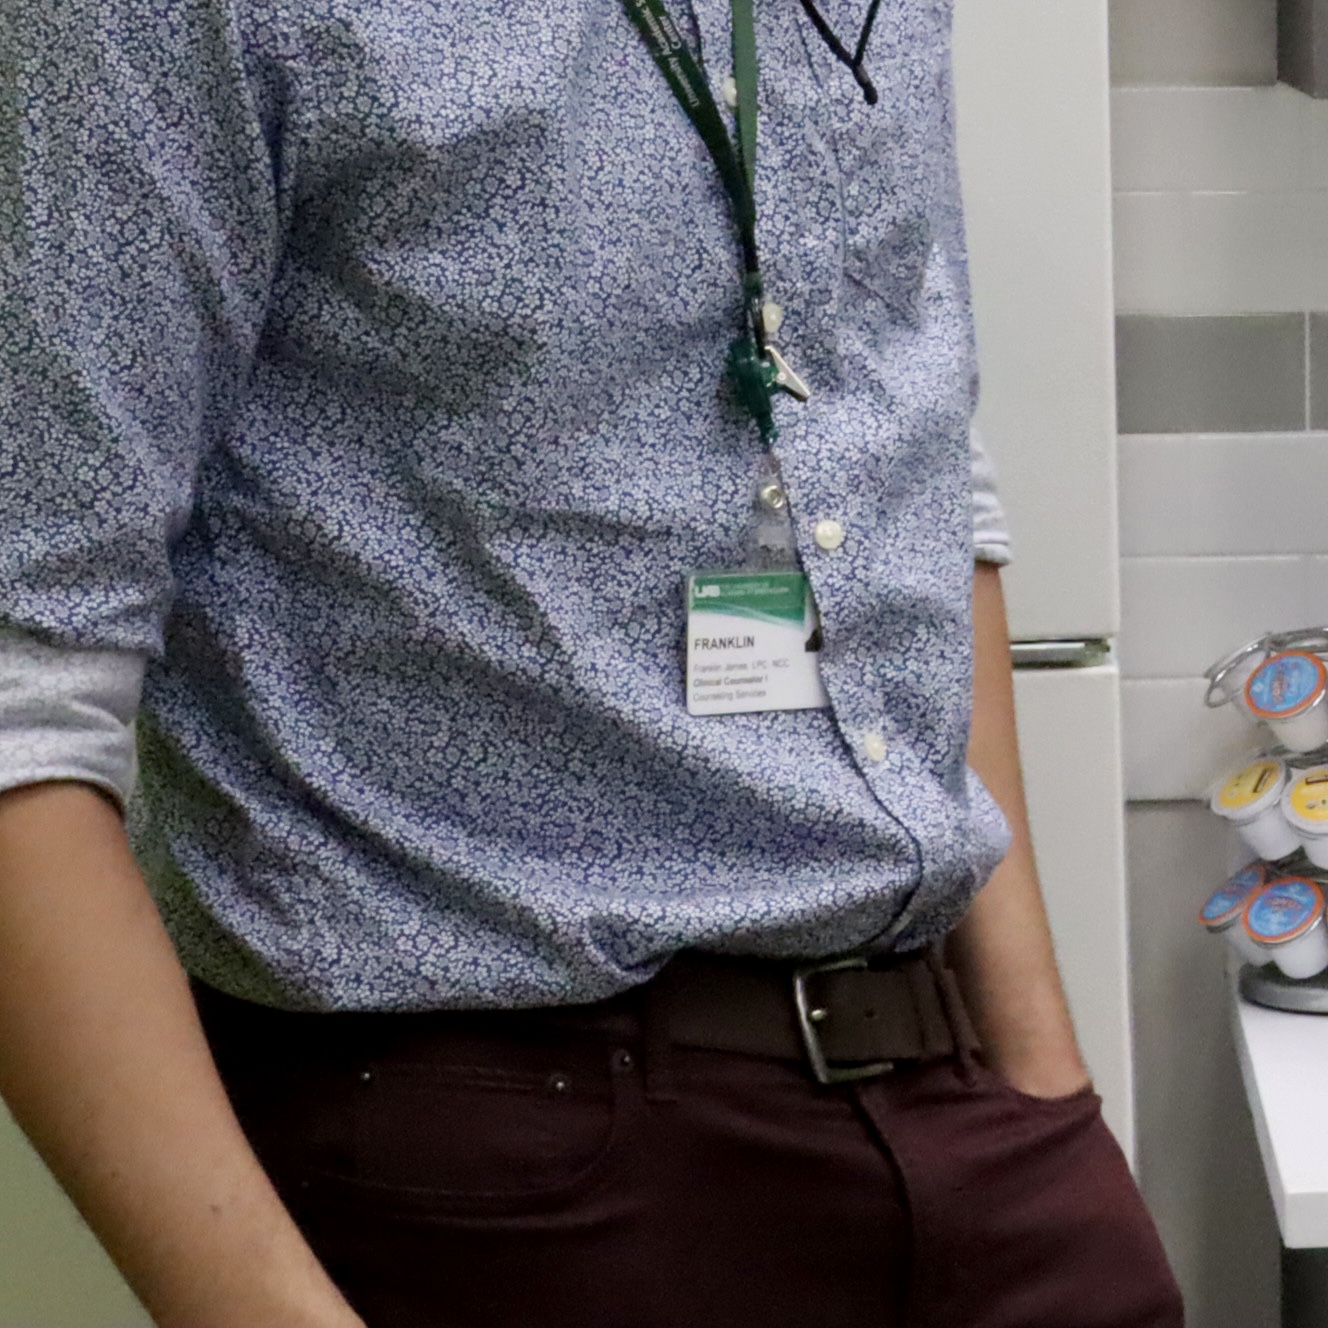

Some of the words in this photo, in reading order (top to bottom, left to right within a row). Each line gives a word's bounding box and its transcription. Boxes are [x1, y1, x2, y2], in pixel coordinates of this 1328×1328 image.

[641, 6, 673, 56] Academic
[659, 15, 683, 50] Center
[667, 57, 700, 109] University
[694, 636, 755, 651] FRANKLIN
